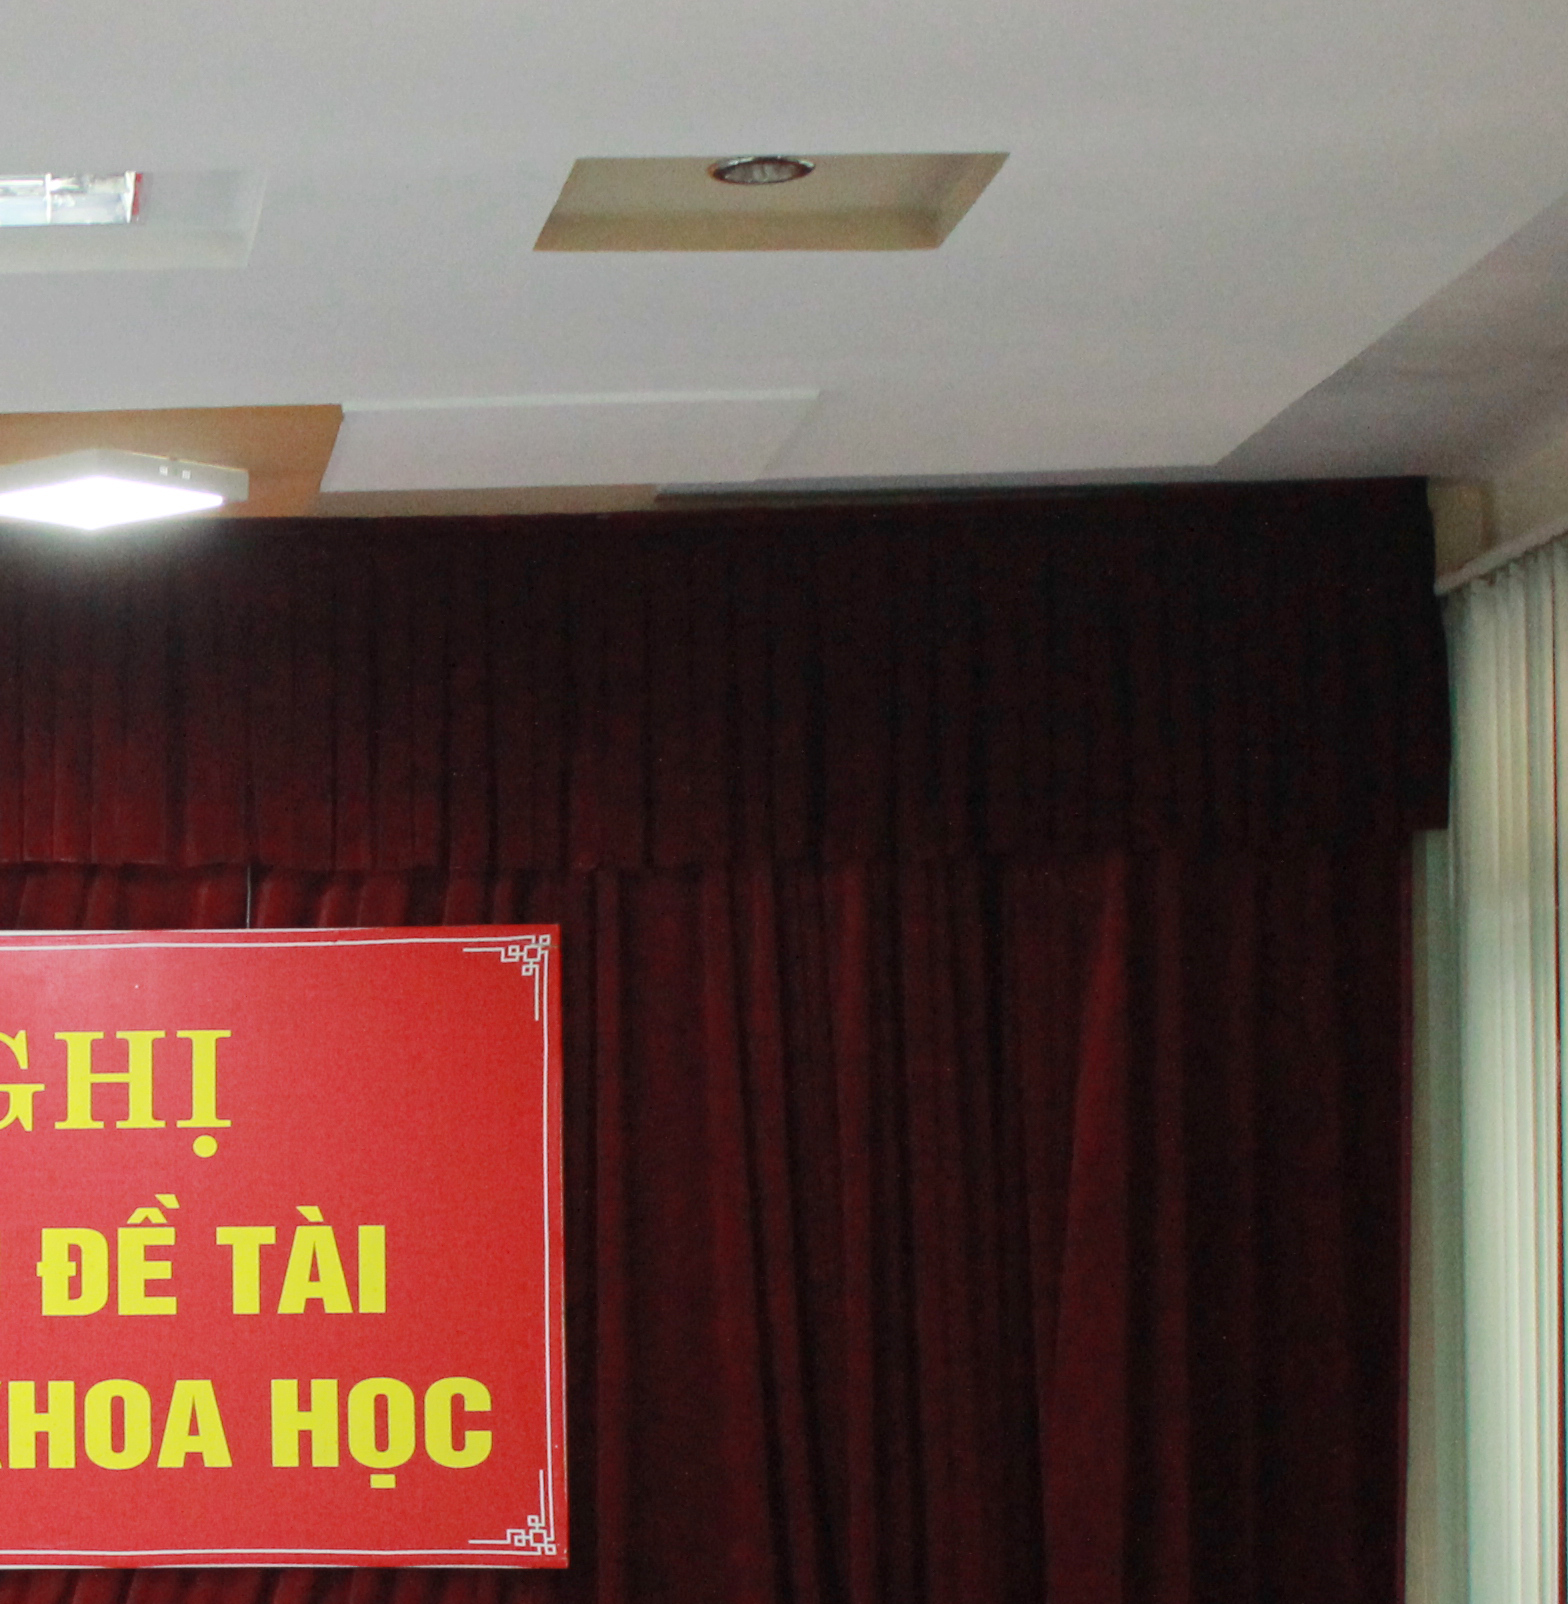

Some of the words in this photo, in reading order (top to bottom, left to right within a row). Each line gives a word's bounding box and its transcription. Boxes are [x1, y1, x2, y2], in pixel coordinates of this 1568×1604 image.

[35, 1193, 182, 1316] ĐỀ
[215, 1205, 387, 1315] TÀI
[270, 1376, 493, 1490] HỌC
